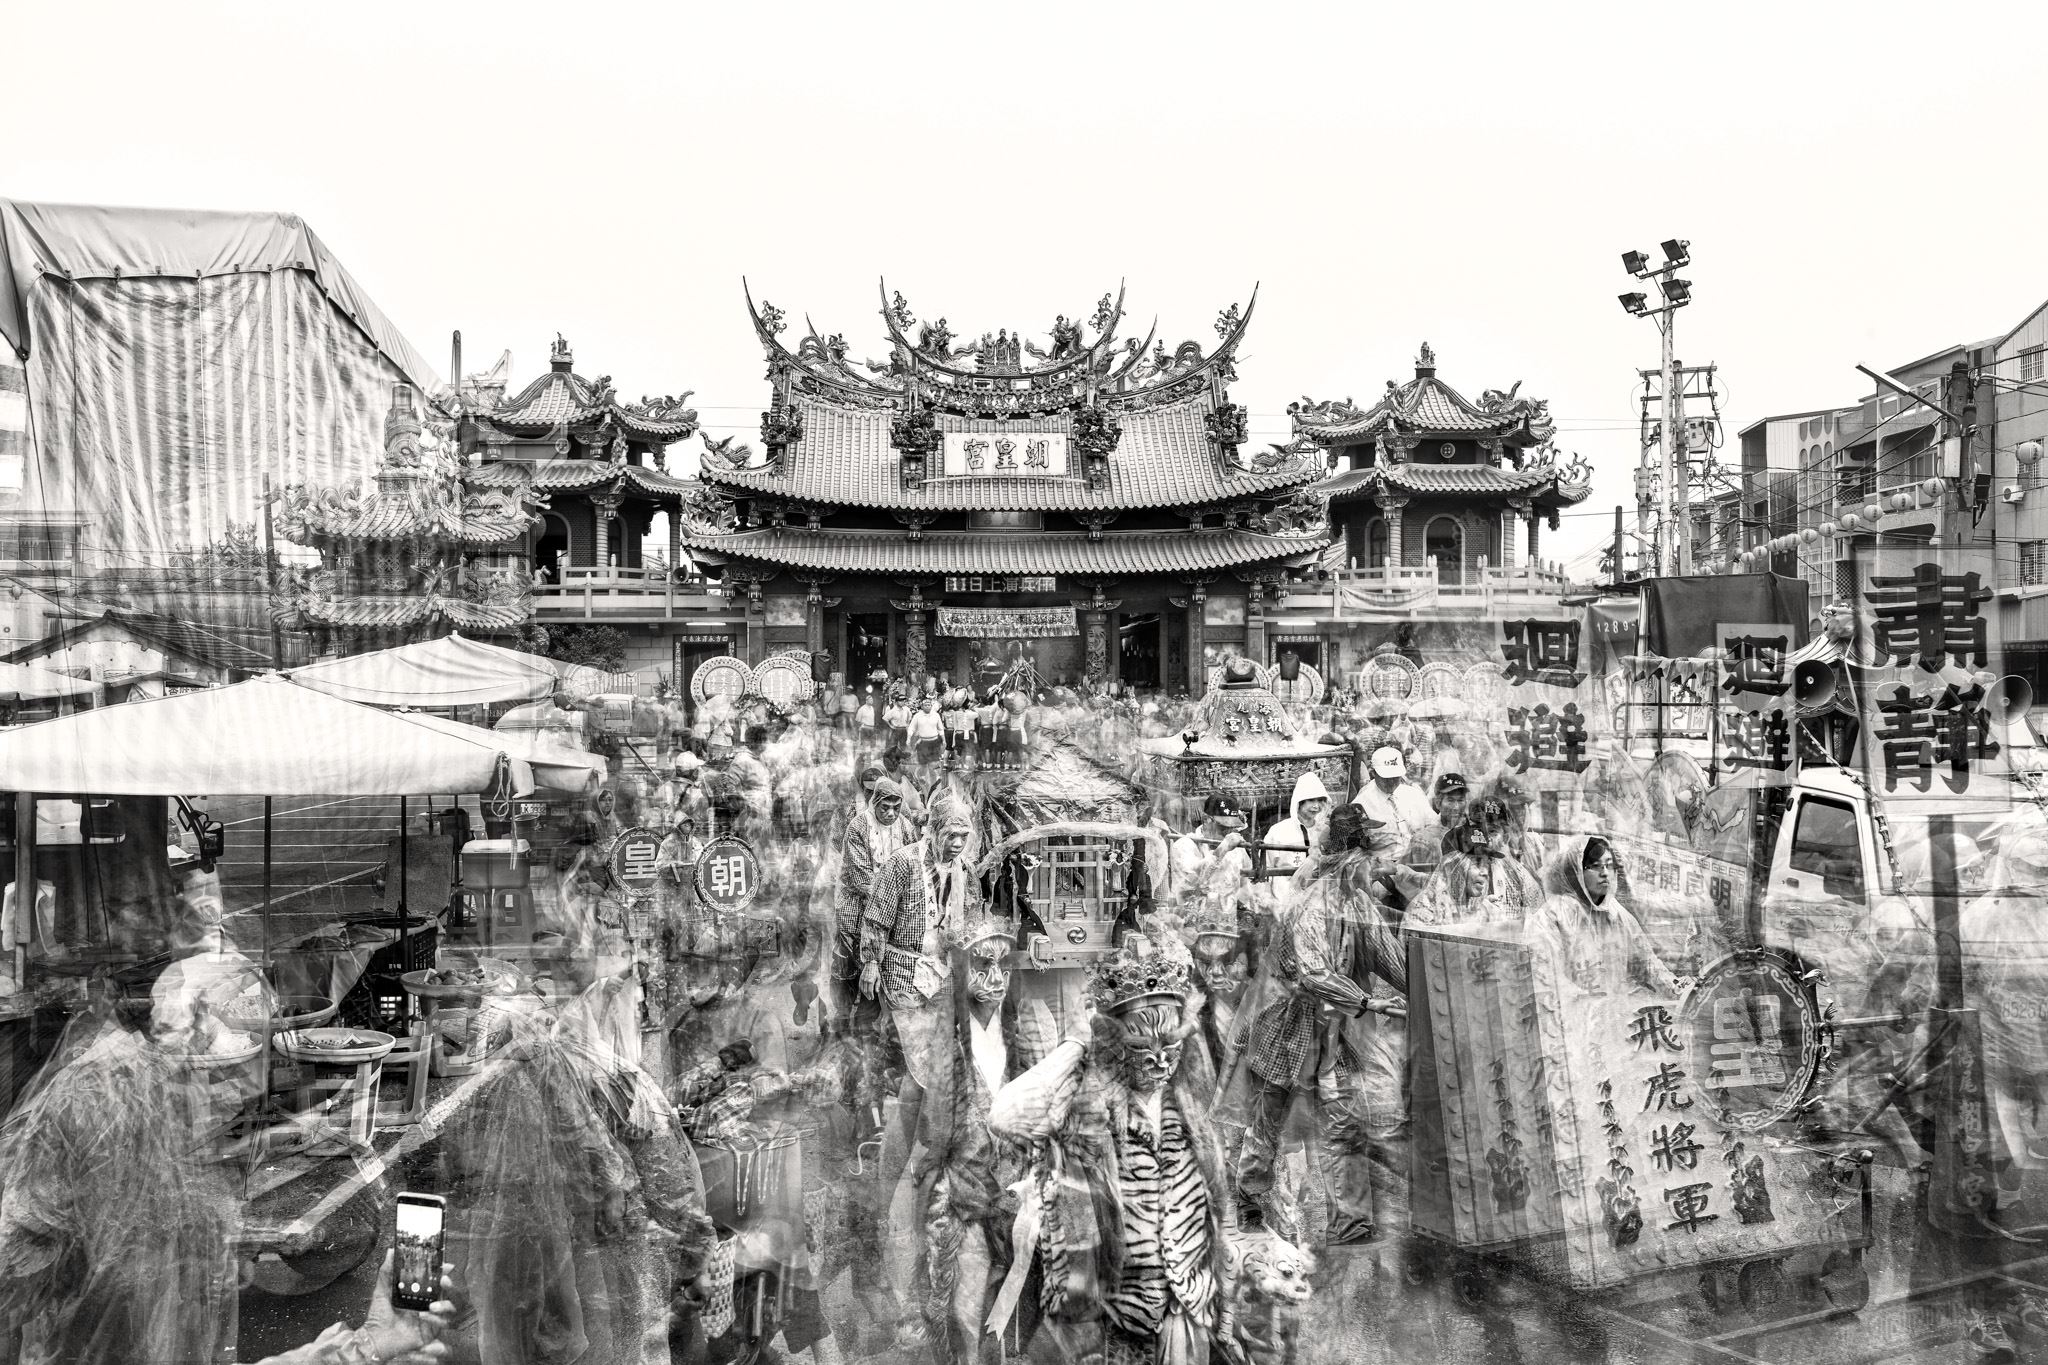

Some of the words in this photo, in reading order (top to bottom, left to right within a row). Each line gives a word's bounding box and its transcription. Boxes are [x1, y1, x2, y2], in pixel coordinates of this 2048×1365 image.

[964, 438, 1050, 469] 朝皇宮
[1225, 715, 1283, 733] 朝皇宮
[622, 841, 659, 880] 皇
[709, 855, 748, 898] 朝
[1704, 988, 1788, 1090] 皇
[1625, 1003, 1720, 1235] 飛虎將軍
